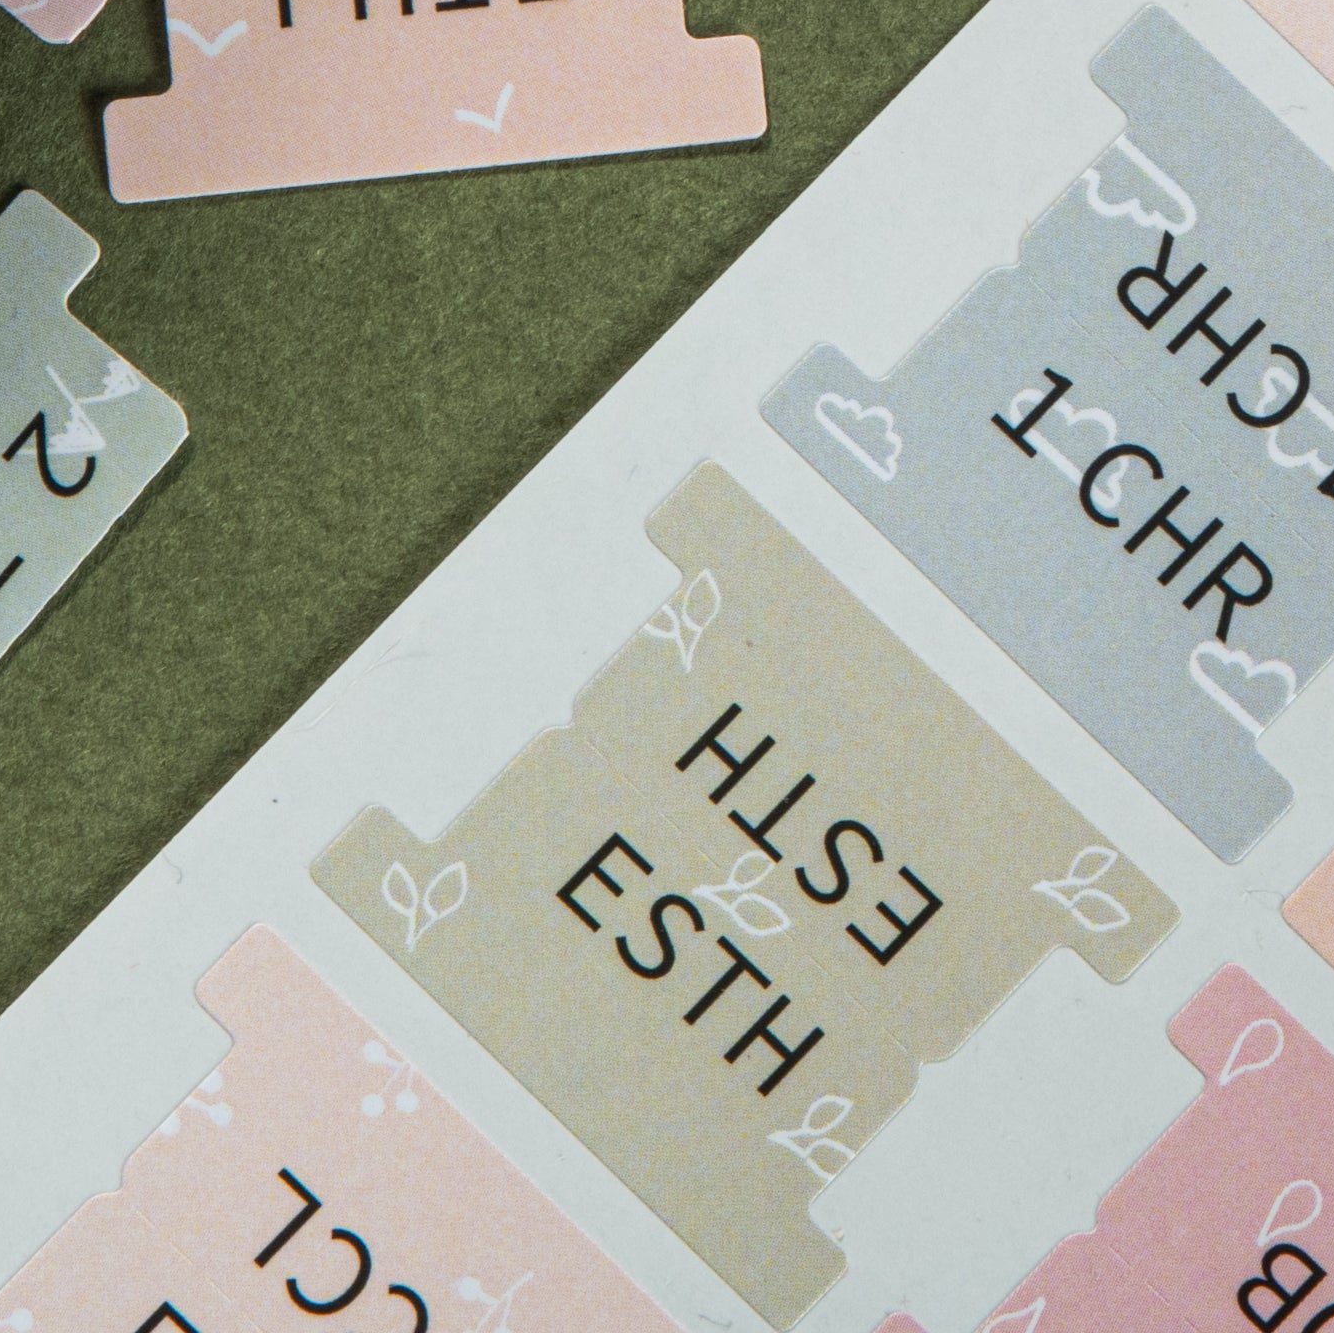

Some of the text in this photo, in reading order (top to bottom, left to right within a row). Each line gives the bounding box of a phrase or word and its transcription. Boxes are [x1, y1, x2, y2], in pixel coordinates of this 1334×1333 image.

[1, 410, 97, 498] 2
[1116, 230, 1311, 429] CHR
[990, 367, 1273, 644] 1 CHR
[556, 832, 825, 1097] ESTH
[675, 703, 944, 967] ESTH
